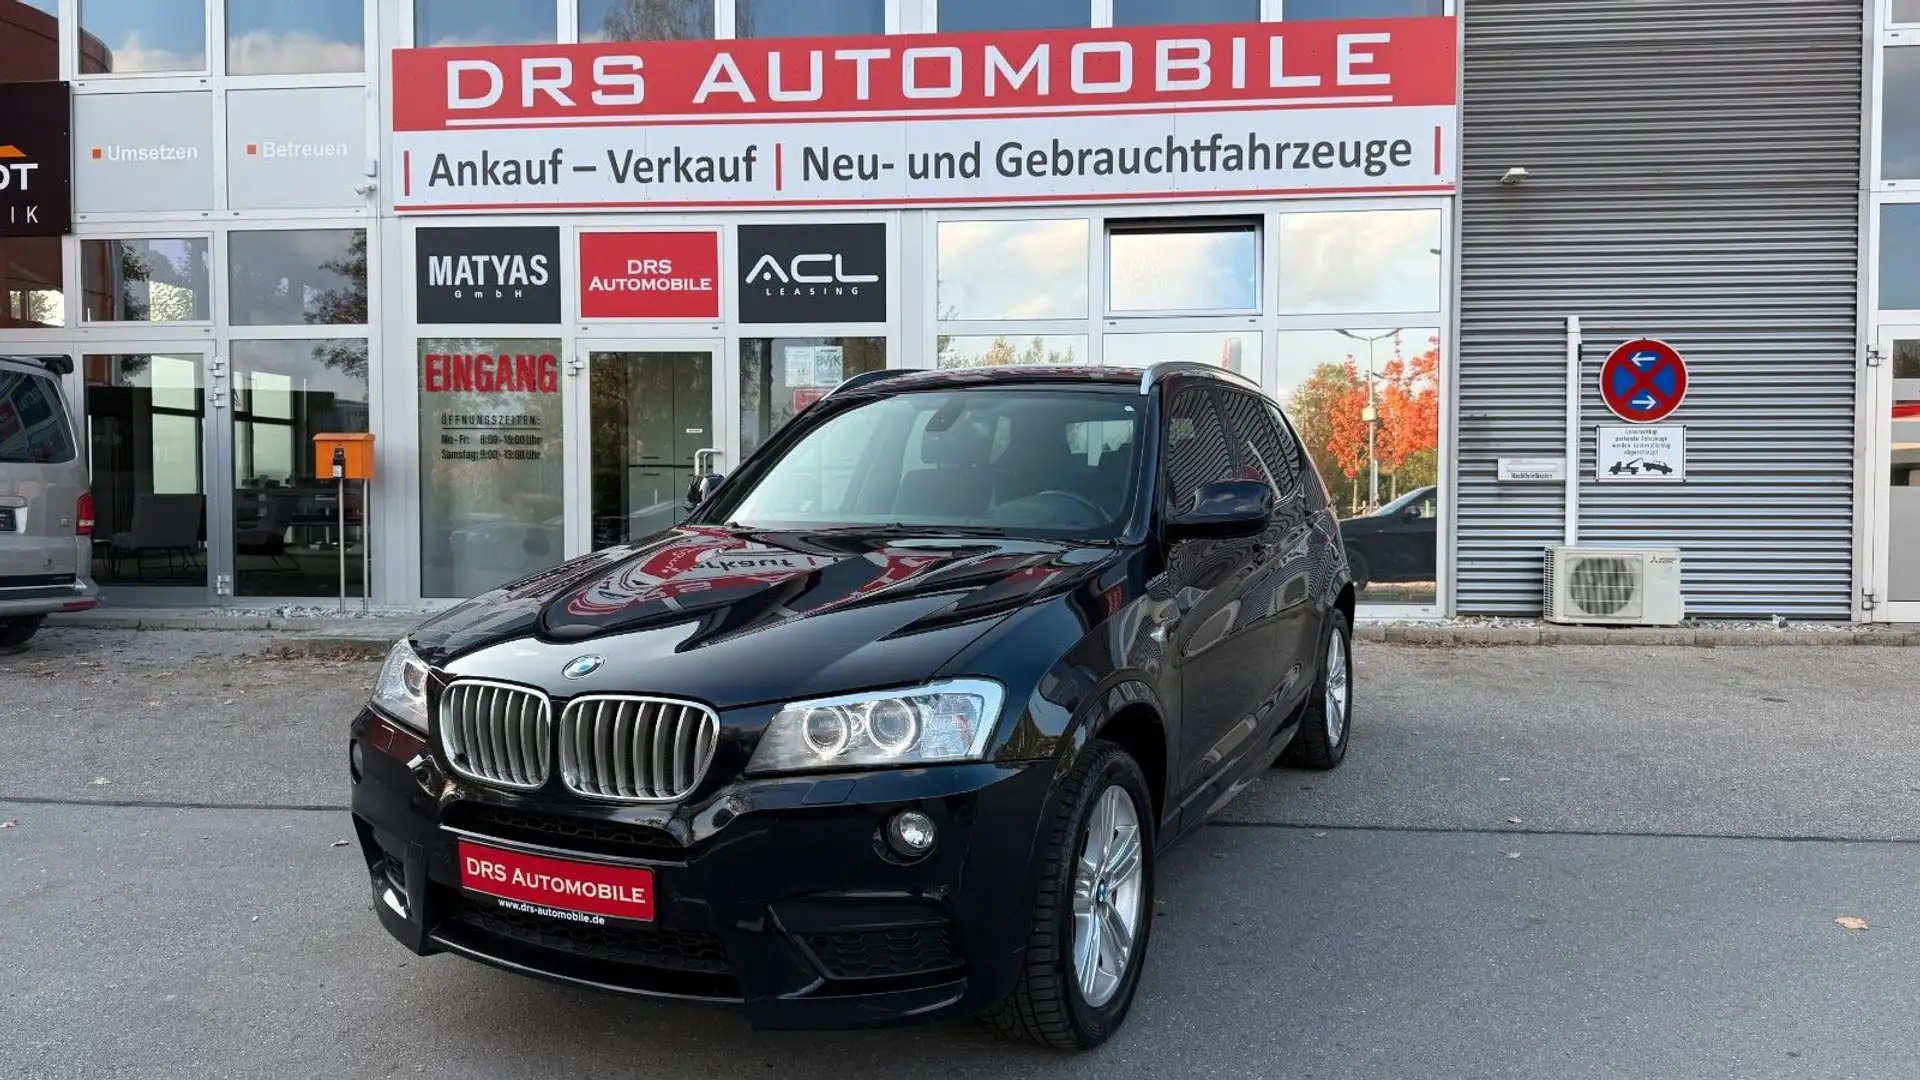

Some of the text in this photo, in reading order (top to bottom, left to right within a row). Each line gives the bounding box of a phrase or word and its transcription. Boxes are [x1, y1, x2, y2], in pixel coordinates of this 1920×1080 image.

[445, 32, 1392, 110] DRS AUTOMOBILE
[107, 144, 198, 161] Umsetzen
[262, 141, 348, 158] Betreuen
[803, 132, 1413, 181] Neu- und Gebrauchtfahrzeuge
[428, 147, 564, 188] Ankauf
[607, 144, 757, 184] Verkauf
[428, 254, 549, 287] MATYAS
[627, 259, 672, 275] DRS
[745, 253, 879, 284] ACL
[454, 289, 522, 299] GmbH
[588, 275, 713, 292] AUTOMOBILE
[766, 286, 859, 297] LEASING
[425, 354, 557, 392] EINGANG
[526, 434, 543, 445] Uhr
[526, 449, 542, 460] Uhr
[466, 857, 646, 904] DRS AUTOMOBILE
[498, 898, 605, 925] www.drs-automobile.de
